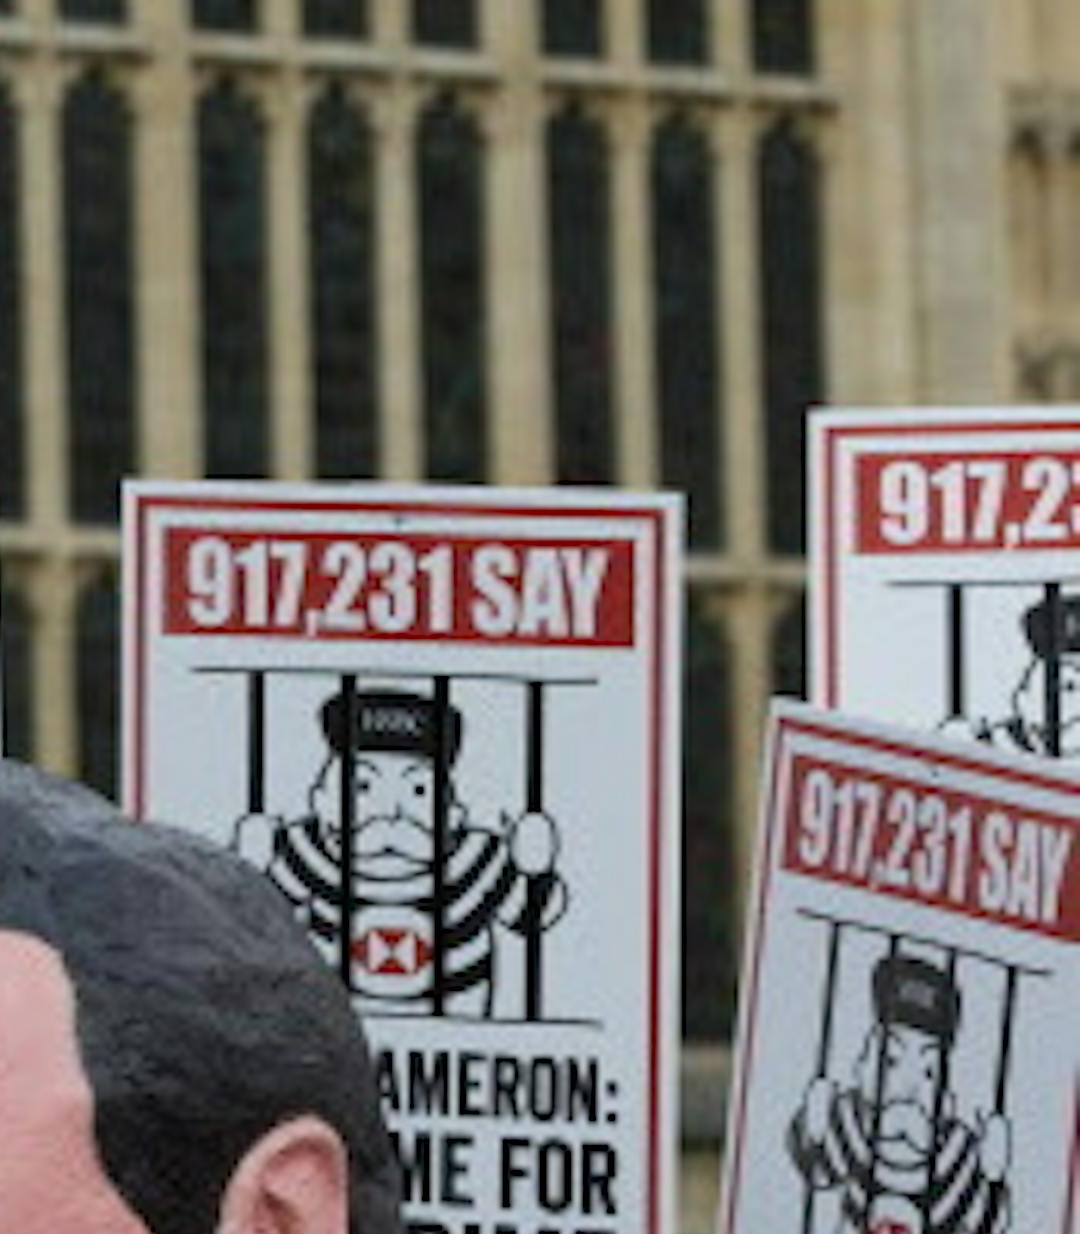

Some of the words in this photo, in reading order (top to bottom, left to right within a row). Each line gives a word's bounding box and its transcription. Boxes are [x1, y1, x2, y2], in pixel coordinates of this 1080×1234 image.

[879, 456, 1080, 549] 917,2
[187, 536, 454, 638] 917,231
[471, 544, 609, 638] SAY
[797, 772, 973, 903] 917,231
[979, 812, 1071, 922] SAY
[375, 1050, 618, 1123] AMERON:
[500, 1138, 616, 1214] FOR
